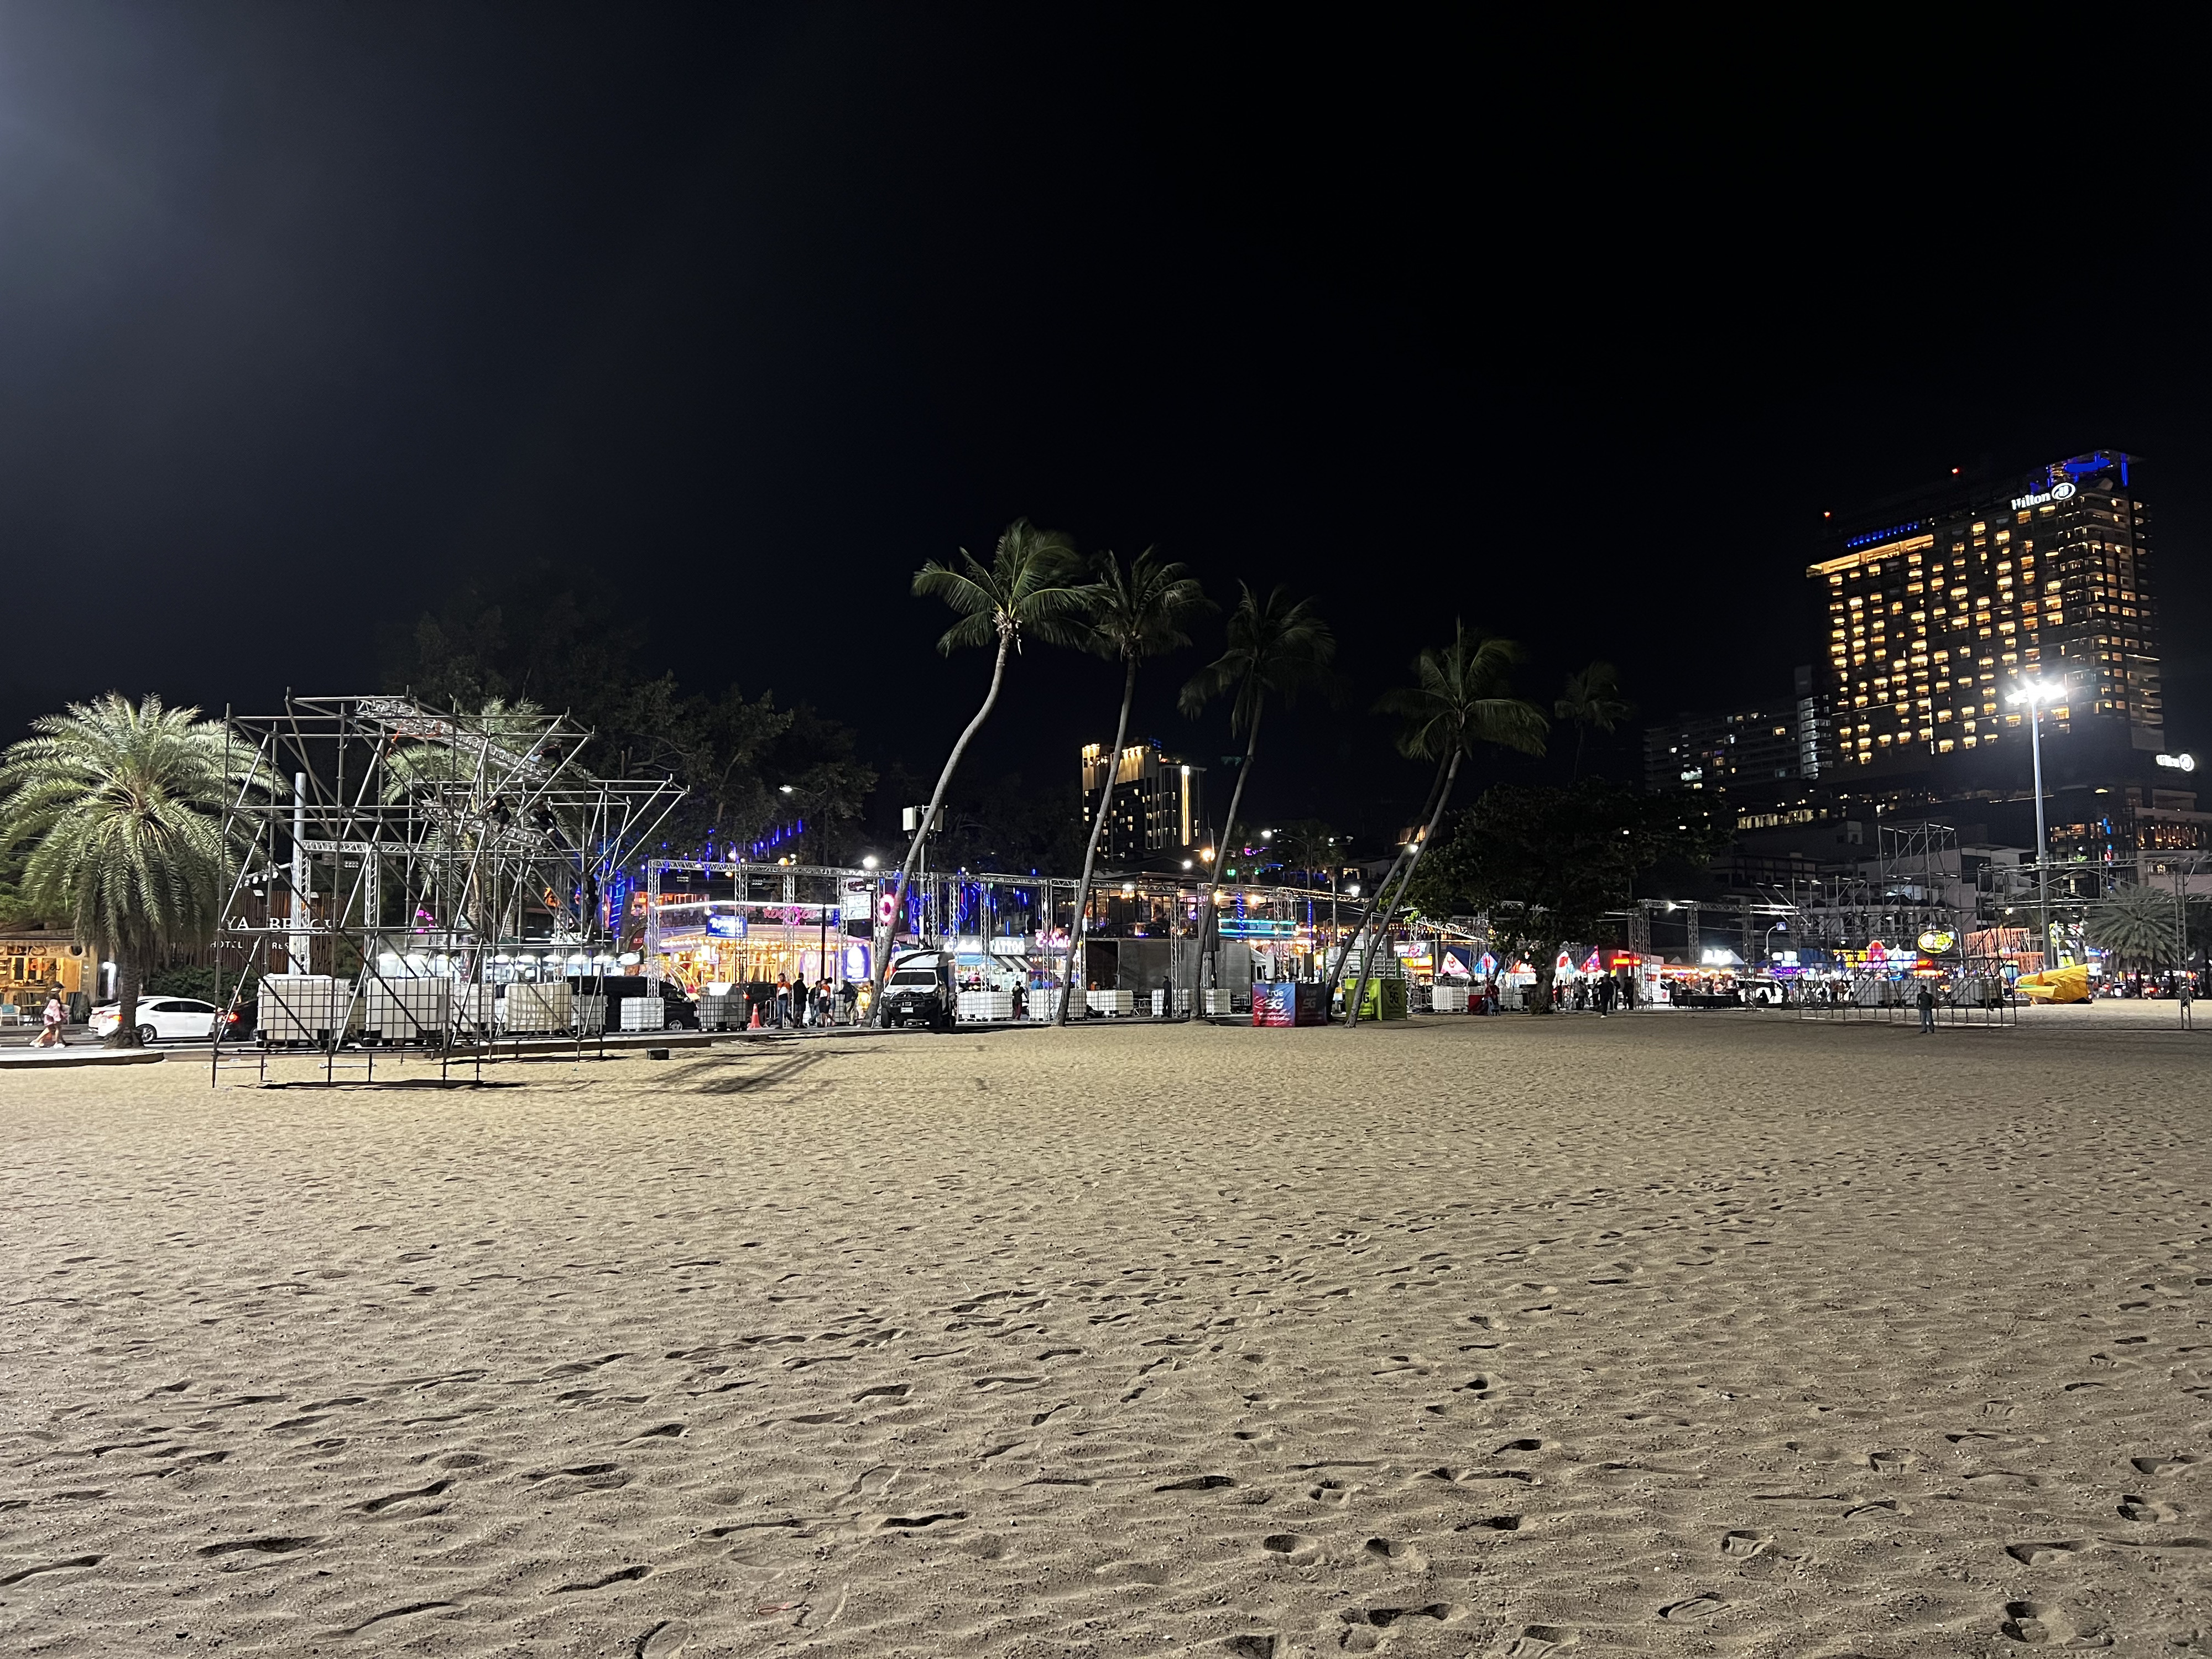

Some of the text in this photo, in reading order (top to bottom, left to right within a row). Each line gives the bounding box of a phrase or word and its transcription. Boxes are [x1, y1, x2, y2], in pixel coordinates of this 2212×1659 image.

[2011, 493, 2051, 510] Hilton
[1264, 998, 1285, 1009] 5G
[1302, 998, 1317, 1009] 5G
[1363, 992, 1370, 1004] G
[1389, 992, 1399, 1004] 5G
